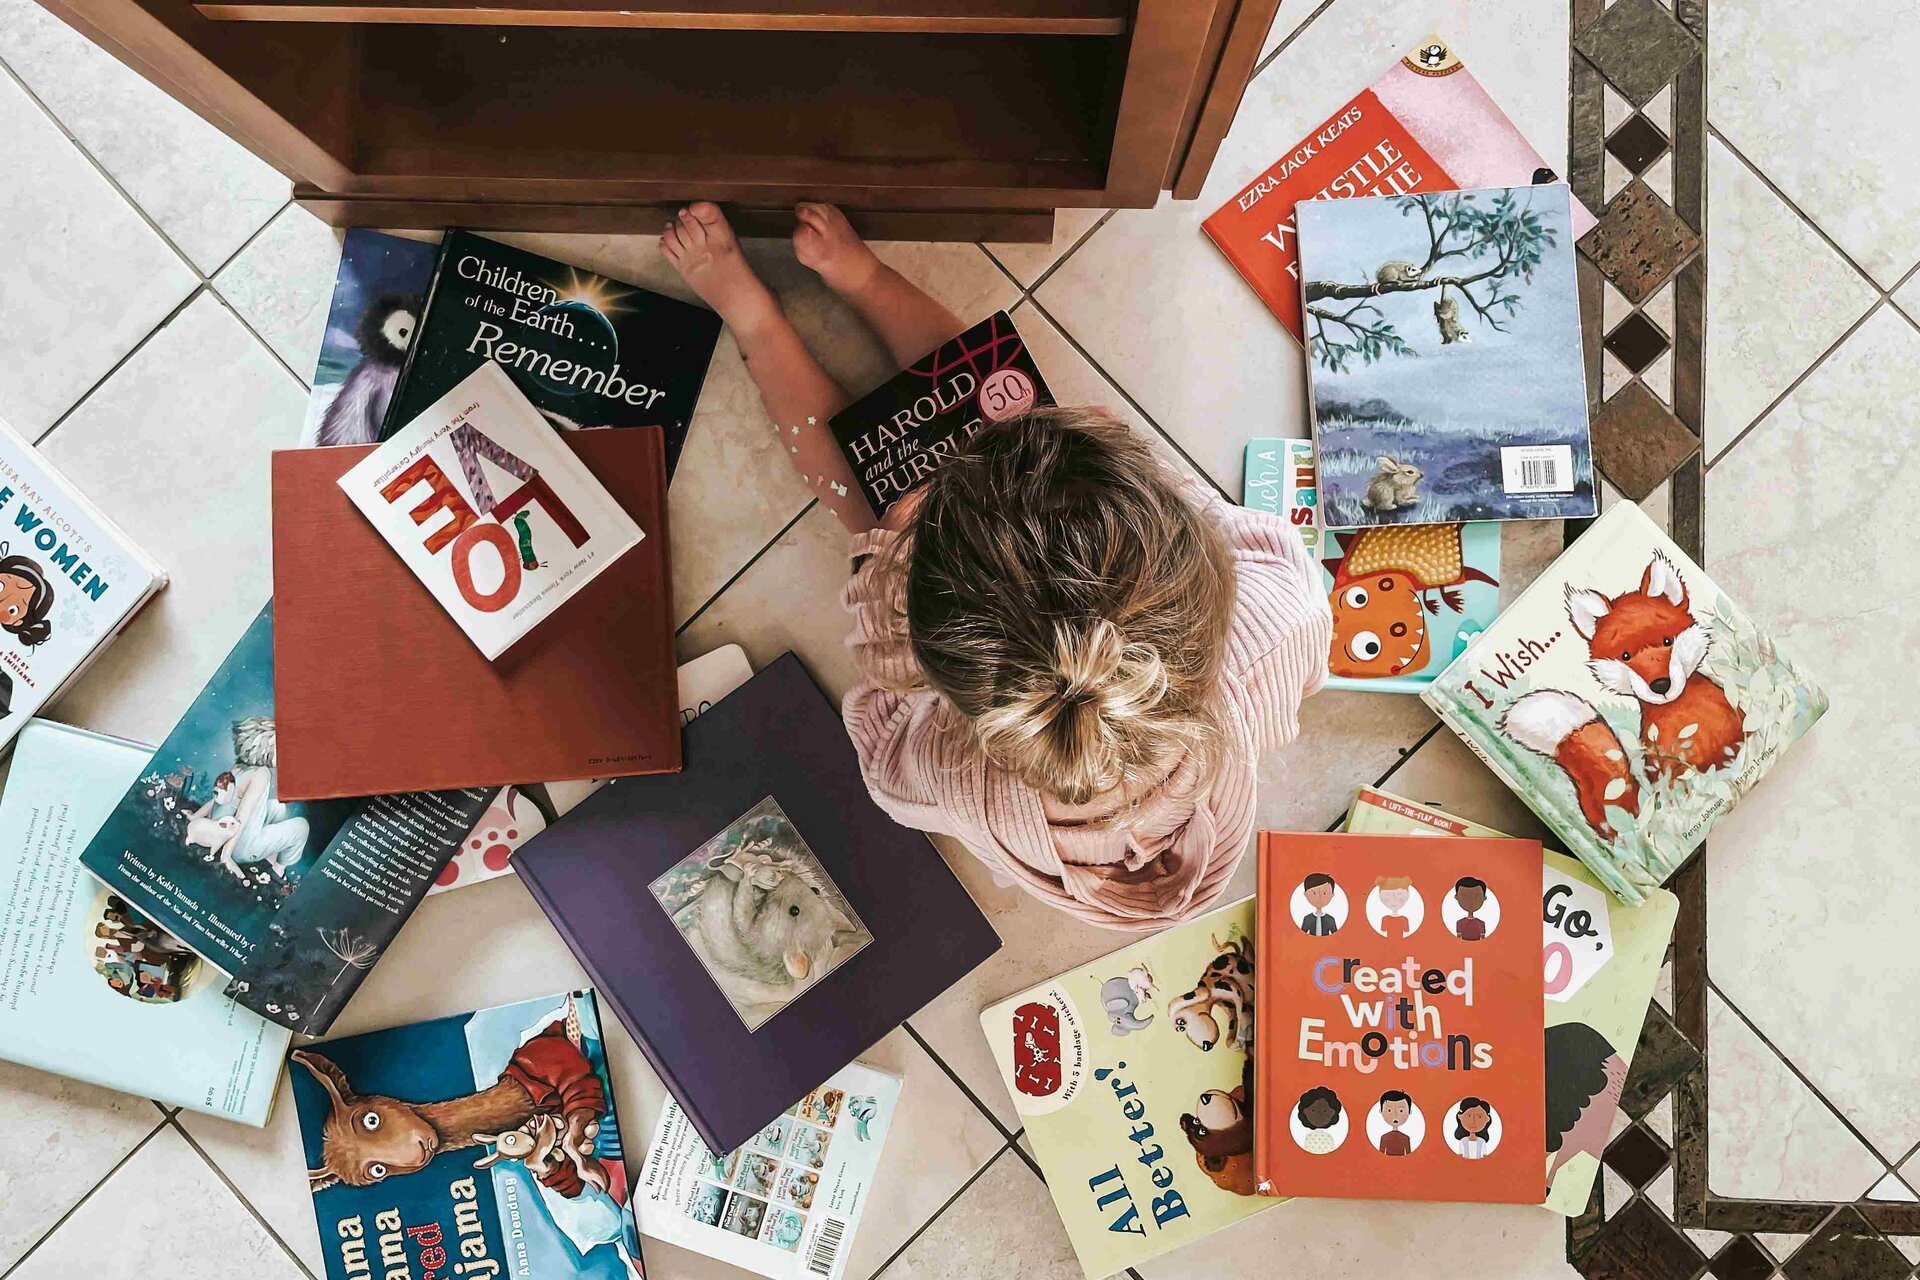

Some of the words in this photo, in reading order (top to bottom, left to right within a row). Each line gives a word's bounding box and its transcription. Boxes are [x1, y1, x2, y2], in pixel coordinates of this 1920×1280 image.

[1237, 175, 1281, 212] EZRA
[1277, 142, 1319, 180] JACK
[1316, 106, 1362, 148] KEATS
[1261, 138, 1403, 254] WISTLE
[457, 255, 557, 306] Children
[465, 295, 481, 308] of
[483, 299, 505, 317] the
[466, 321, 665, 411] Remember
[450, 414, 464, 426] The
[463, 401, 480, 416] from
[847, 371, 977, 465] HAROLD
[408, 436, 435, 458] Hungry
[433, 423, 452, 439] Very
[862, 448, 896, 482] and
[894, 436, 920, 460] the
[1257, 450, 1276, 460] A
[370, 455, 410, 488] Caterpillar
[1248, 463, 1279, 512] uch
[19, 482, 44, 505] MAY
[42, 505, 92, 553] ALCOTT'S
[14, 503, 109, 602] WOMEN
[572, 557, 587, 570] New
[540, 580, 560, 596] Times
[558, 568, 574, 582] York
[8, 650, 20, 662] ART
[20, 662, 30, 670] BY
[1464, 678, 1494, 710] I
[1481, 628, 1562, 690] Wish...
[1733, 765, 1756, 787] Kirsten
[45, 804, 54, 822] soon
[57, 803, 70, 822] final
[388, 818, 400, 828] and
[1381, 799, 1387, 808] A
[1386, 802, 1433, 822] LIFT-THE-FLAP
[1433, 818, 1452, 829] BOOK!
[1681, 820, 1702, 840] Penny
[1700, 796, 1725, 822] Johnson
[41, 825, 49, 837] are
[66, 828, 76, 844] this
[354, 820, 378, 840] Gabriella
[376, 836, 393, 850] draws
[391, 845, 420, 866] inspiration
[419, 861, 432, 872] from
[360, 812, 372, 823] that
[391, 834, 410, 848] people
[410, 844, 418, 852] of
[416, 848, 426, 856] all
[3, 909, 12, 924] into
[18, 855, 26, 864] he
[24, 807, 40, 844] welcomed
[33, 840, 46, 866] priests
[46, 850, 58, 862] of
[58, 856, 70, 868] life
[64, 846, 72, 854] in
[334, 848, 346, 858] She
[344, 854, 365, 872] remains
[364, 868, 382, 882] deeply
[340, 840, 358, 854] enjoys
[386, 868, 398, 878] and
[347, 830, 358, 840] her
[356, 836, 382, 856] collection
[417, 872, 428, 881] and
[24, 868, 38, 893] Temple
[42, 864, 55, 882] story
[57, 870, 66, 878] to
[117, 863, 132, 878] From
[130, 874, 141, 883] the
[138, 880, 158, 896] author
[156, 892, 164, 900] of
[162, 898, 172, 907] the
[341, 879, 352, 888] her
[350, 886, 367, 898] debut
[362, 880, 387, 898] especially
[20, 896, 30, 908] the
[35, 884, 50, 913] moving
[47, 880, 64, 912] brought
[122, 850, 148, 872] Written
[146, 868, 157, 880] by
[155, 874, 175, 892] Kobi
[172, 886, 200, 910] Yamada
[207, 913, 242, 941] Illustrated
[238, 936, 250, 950] by
[15, 910, 26, 924] But
[28, 914, 40, 928] The
[38, 914, 56, 952] sensitively
[46, 931, 66, 974] charmingly
[58, 889, 75, 929] illustrated
[1543, 884, 1604, 952] Go,
[18, 950, 31, 978] against
[37, 954, 43, 962] is
[0, 958, 17, 991] cheering
[28, 964, 44, 996] journey
[1313, 955, 1473, 1006] Created
[8, 979, 25, 1011] plotting
[1048, 989, 1075, 1028] stickers!
[1340, 989, 1442, 1039] with
[1070, 1028, 1084, 1068] bandage
[1298, 1016, 1493, 1074] Emotions
[1059, 1080, 1079, 1100] With
[644, 1166, 658, 1186] Turn
[651, 1144, 664, 1166] little
[659, 1120, 674, 1144] pouts
[1094, 1061, 1191, 1231] Better!
[500, 1177, 524, 1239] Dewdney
[1088, 1163, 1147, 1238] All
[514, 1242, 530, 1277] Anna
